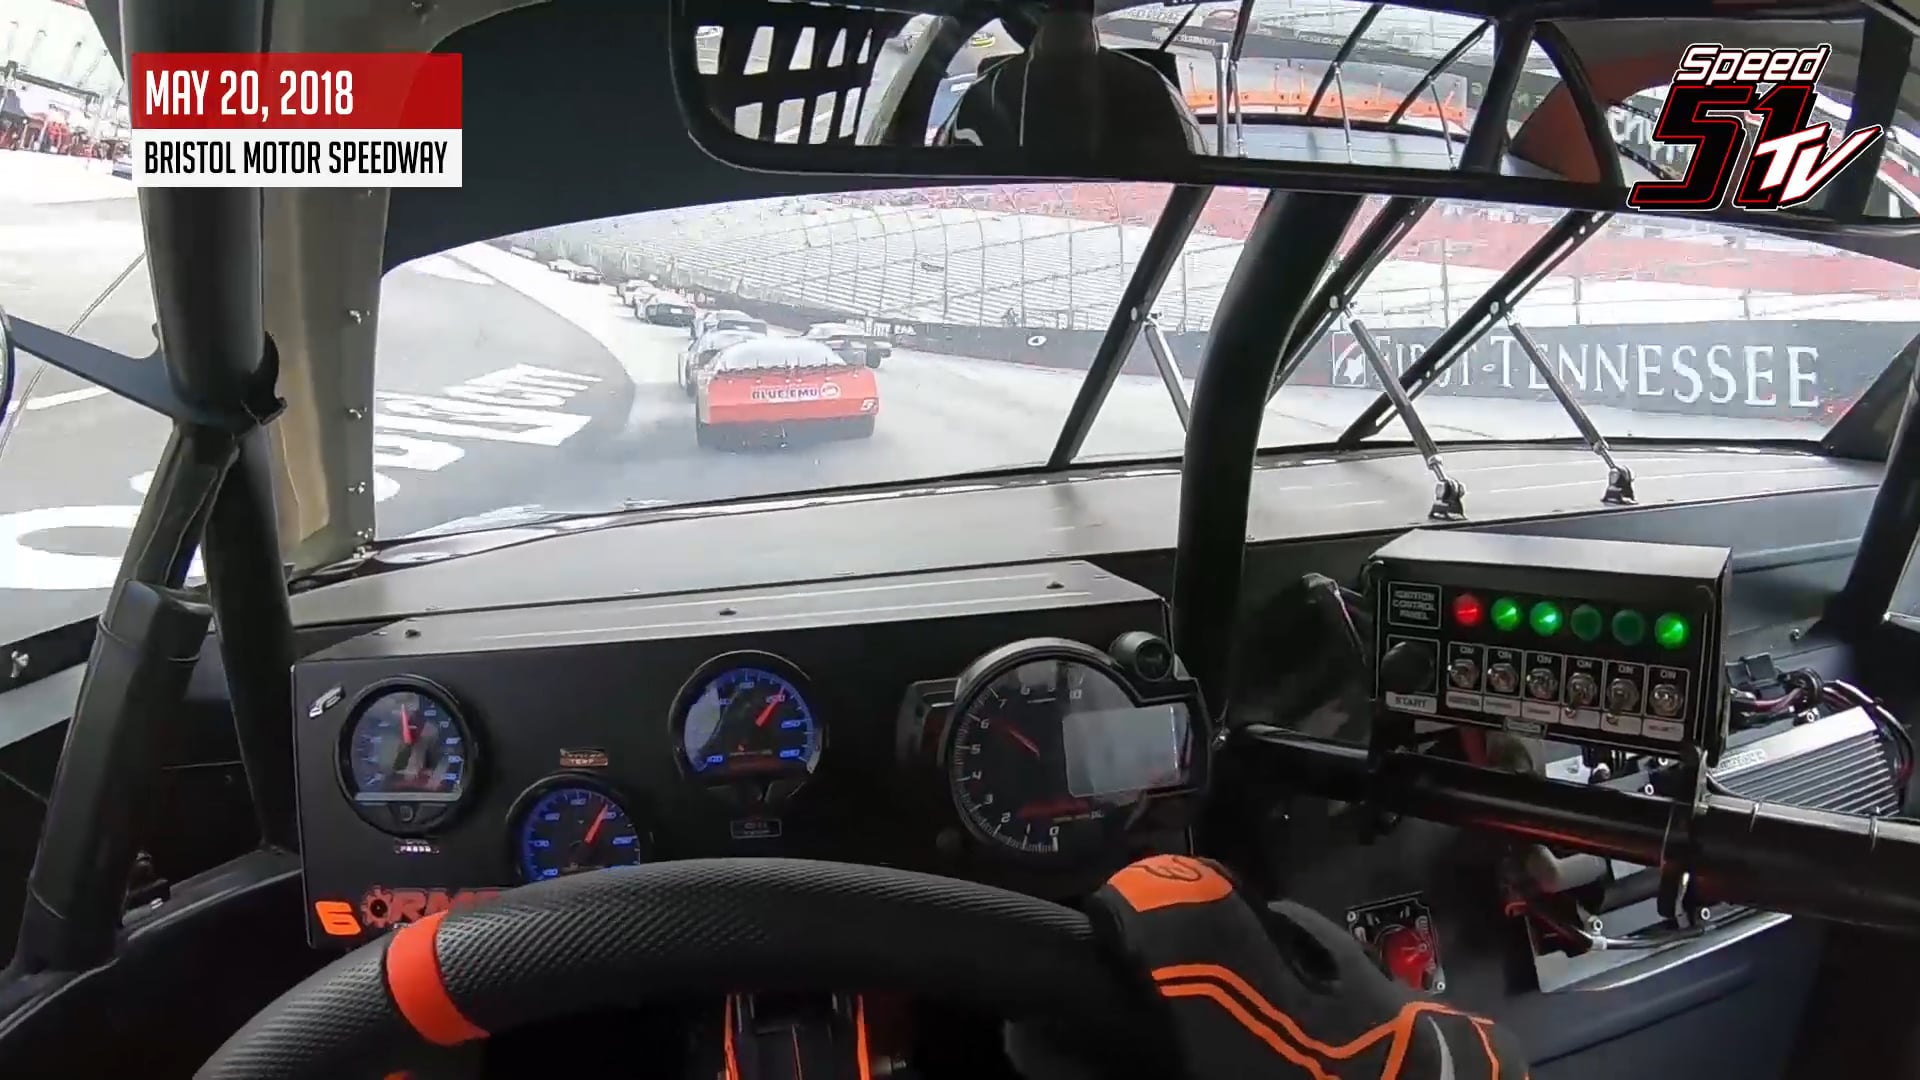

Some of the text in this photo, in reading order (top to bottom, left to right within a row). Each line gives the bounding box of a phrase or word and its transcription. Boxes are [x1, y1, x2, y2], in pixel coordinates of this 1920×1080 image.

[1459, 645, 1474, 654] ON
[1497, 649, 1512, 660] ON
[1536, 653, 1552, 665] ON
[1576, 659, 1593, 669] ON
[1618, 664, 1635, 675] ON
[1660, 669, 1677, 680] ON
[1394, 695, 1428, 709] START
[980, 718, 990, 730] 6
[971, 743, 982, 755] 5
[972, 770, 982, 780] 4
[984, 794, 994, 804] 3
[1000, 812, 1012, 824] 2
[314, 900, 362, 936] 6
